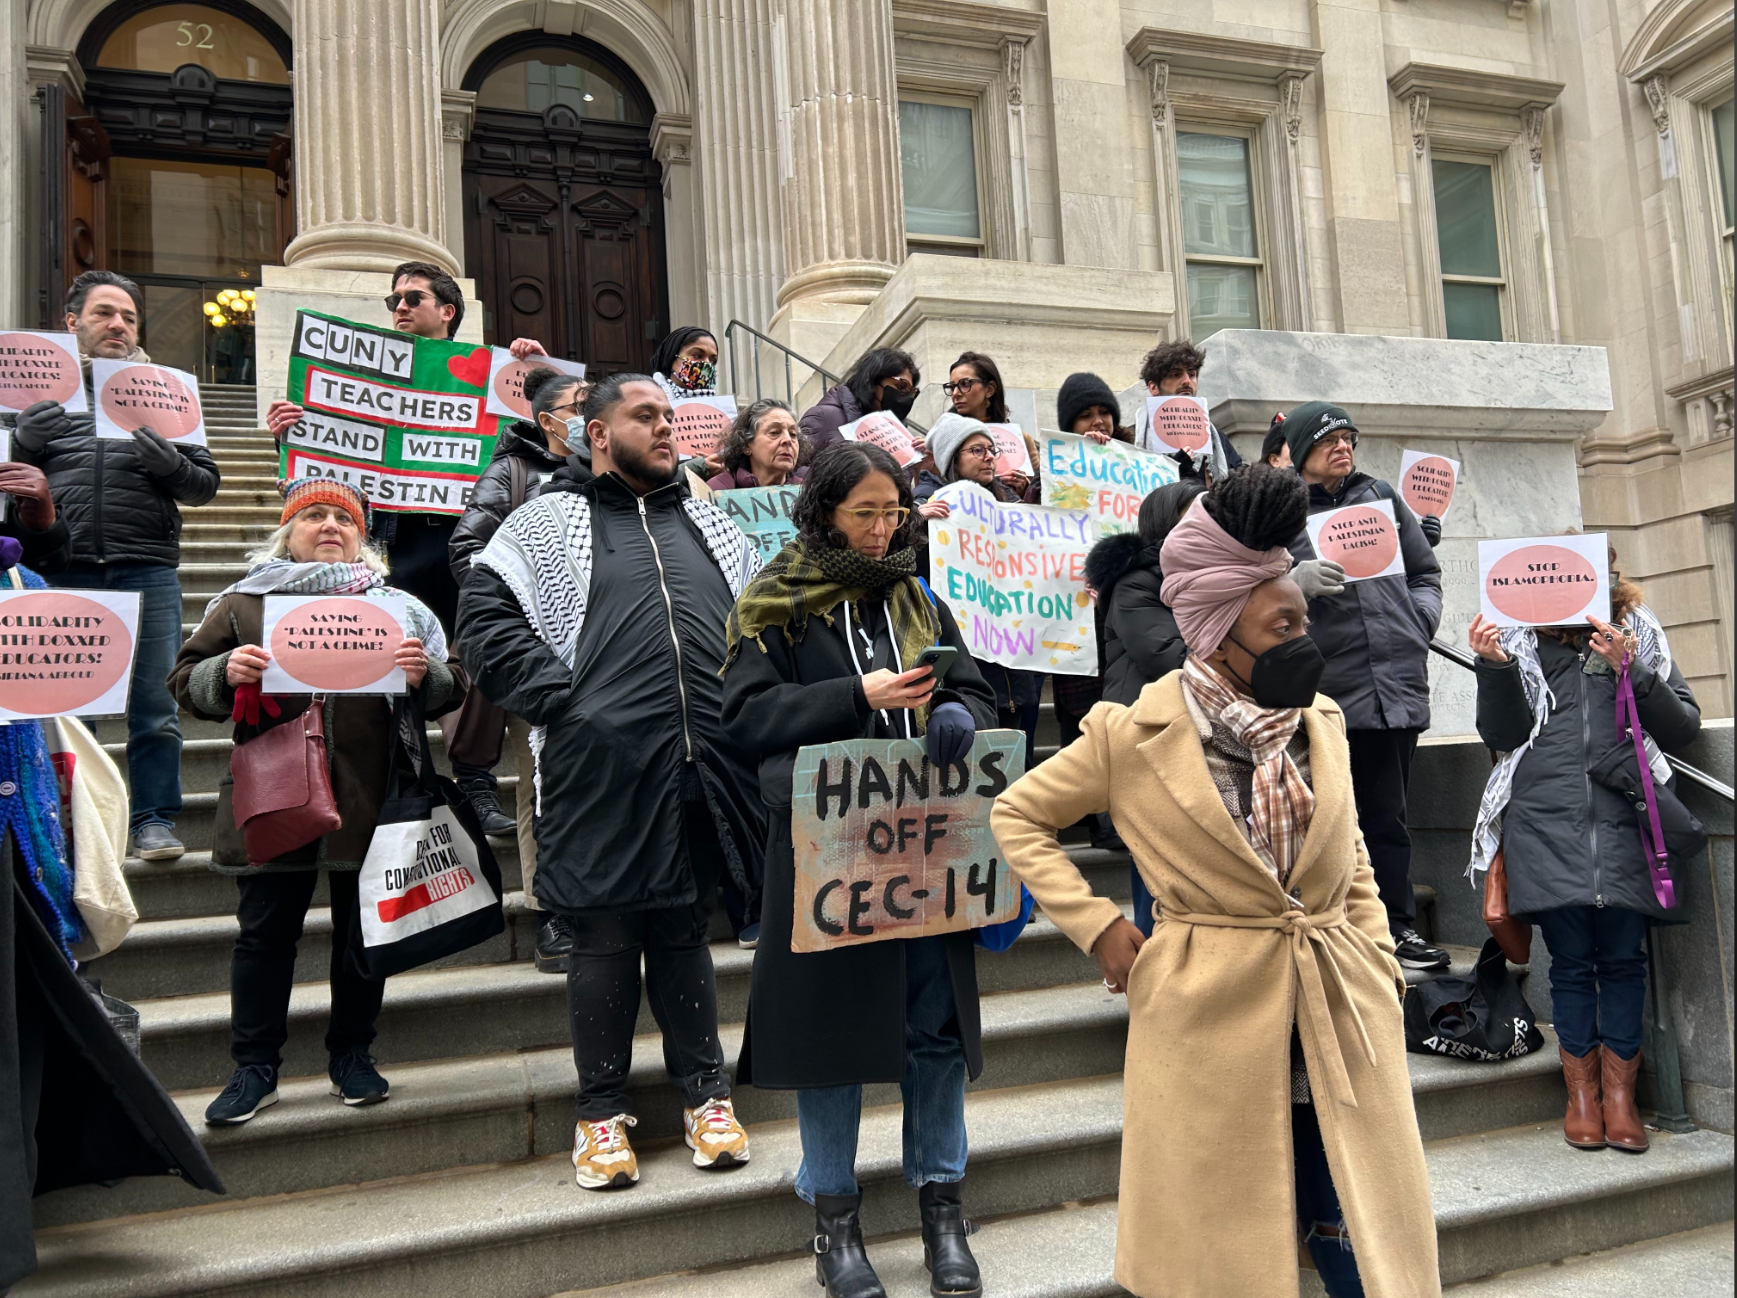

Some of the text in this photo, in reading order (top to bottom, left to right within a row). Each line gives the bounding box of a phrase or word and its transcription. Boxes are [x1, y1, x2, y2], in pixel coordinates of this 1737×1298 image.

[176, 21, 214, 49] 52
[0, 347, 55, 356] LIDARITY
[304, 326, 408, 372] CUNY
[14, 359, 62, 368] DOXXED
[0, 371, 61, 380] UCATORS!
[131, 377, 170, 389] SAYING
[114, 399, 188, 413] NOT A CRIME!
[180, 395, 189, 404] IS
[321, 378, 472, 422] TEACHERS
[674, 413, 724, 423] ULTURALLY
[291, 420, 477, 460] STAND WITH
[708, 490, 798, 523] AND
[1098, 490, 1142, 523] FOR
[1331, 517, 1378, 531] STOP ANTI
[1328, 527, 1385, 542] PALESTINIAN
[1342, 539, 1378, 550] RACISM!
[1527, 562, 1560, 572] STOP
[1492, 574, 1595, 586] ISLAMOPHOBIA.
[946, 566, 1073, 621] EDUCATION
[0, 615, 104, 628] OLIDARITY
[310, 614, 362, 623] SAYING
[375, 628, 388, 637] IS
[973, 614, 1035, 656] NOW
[0, 634, 111, 647] ITH DOXXED
[287, 640, 384, 651] NOT A CRIME!
[47, 671, 94, 679] ABBOUD
[815, 751, 1008, 822] HANDS
[430, 823, 453, 848] FOR
[866, 813, 949, 856] OFF
[426, 867, 470, 902] RIGHTS
[812, 857, 998, 937] CEC-14
